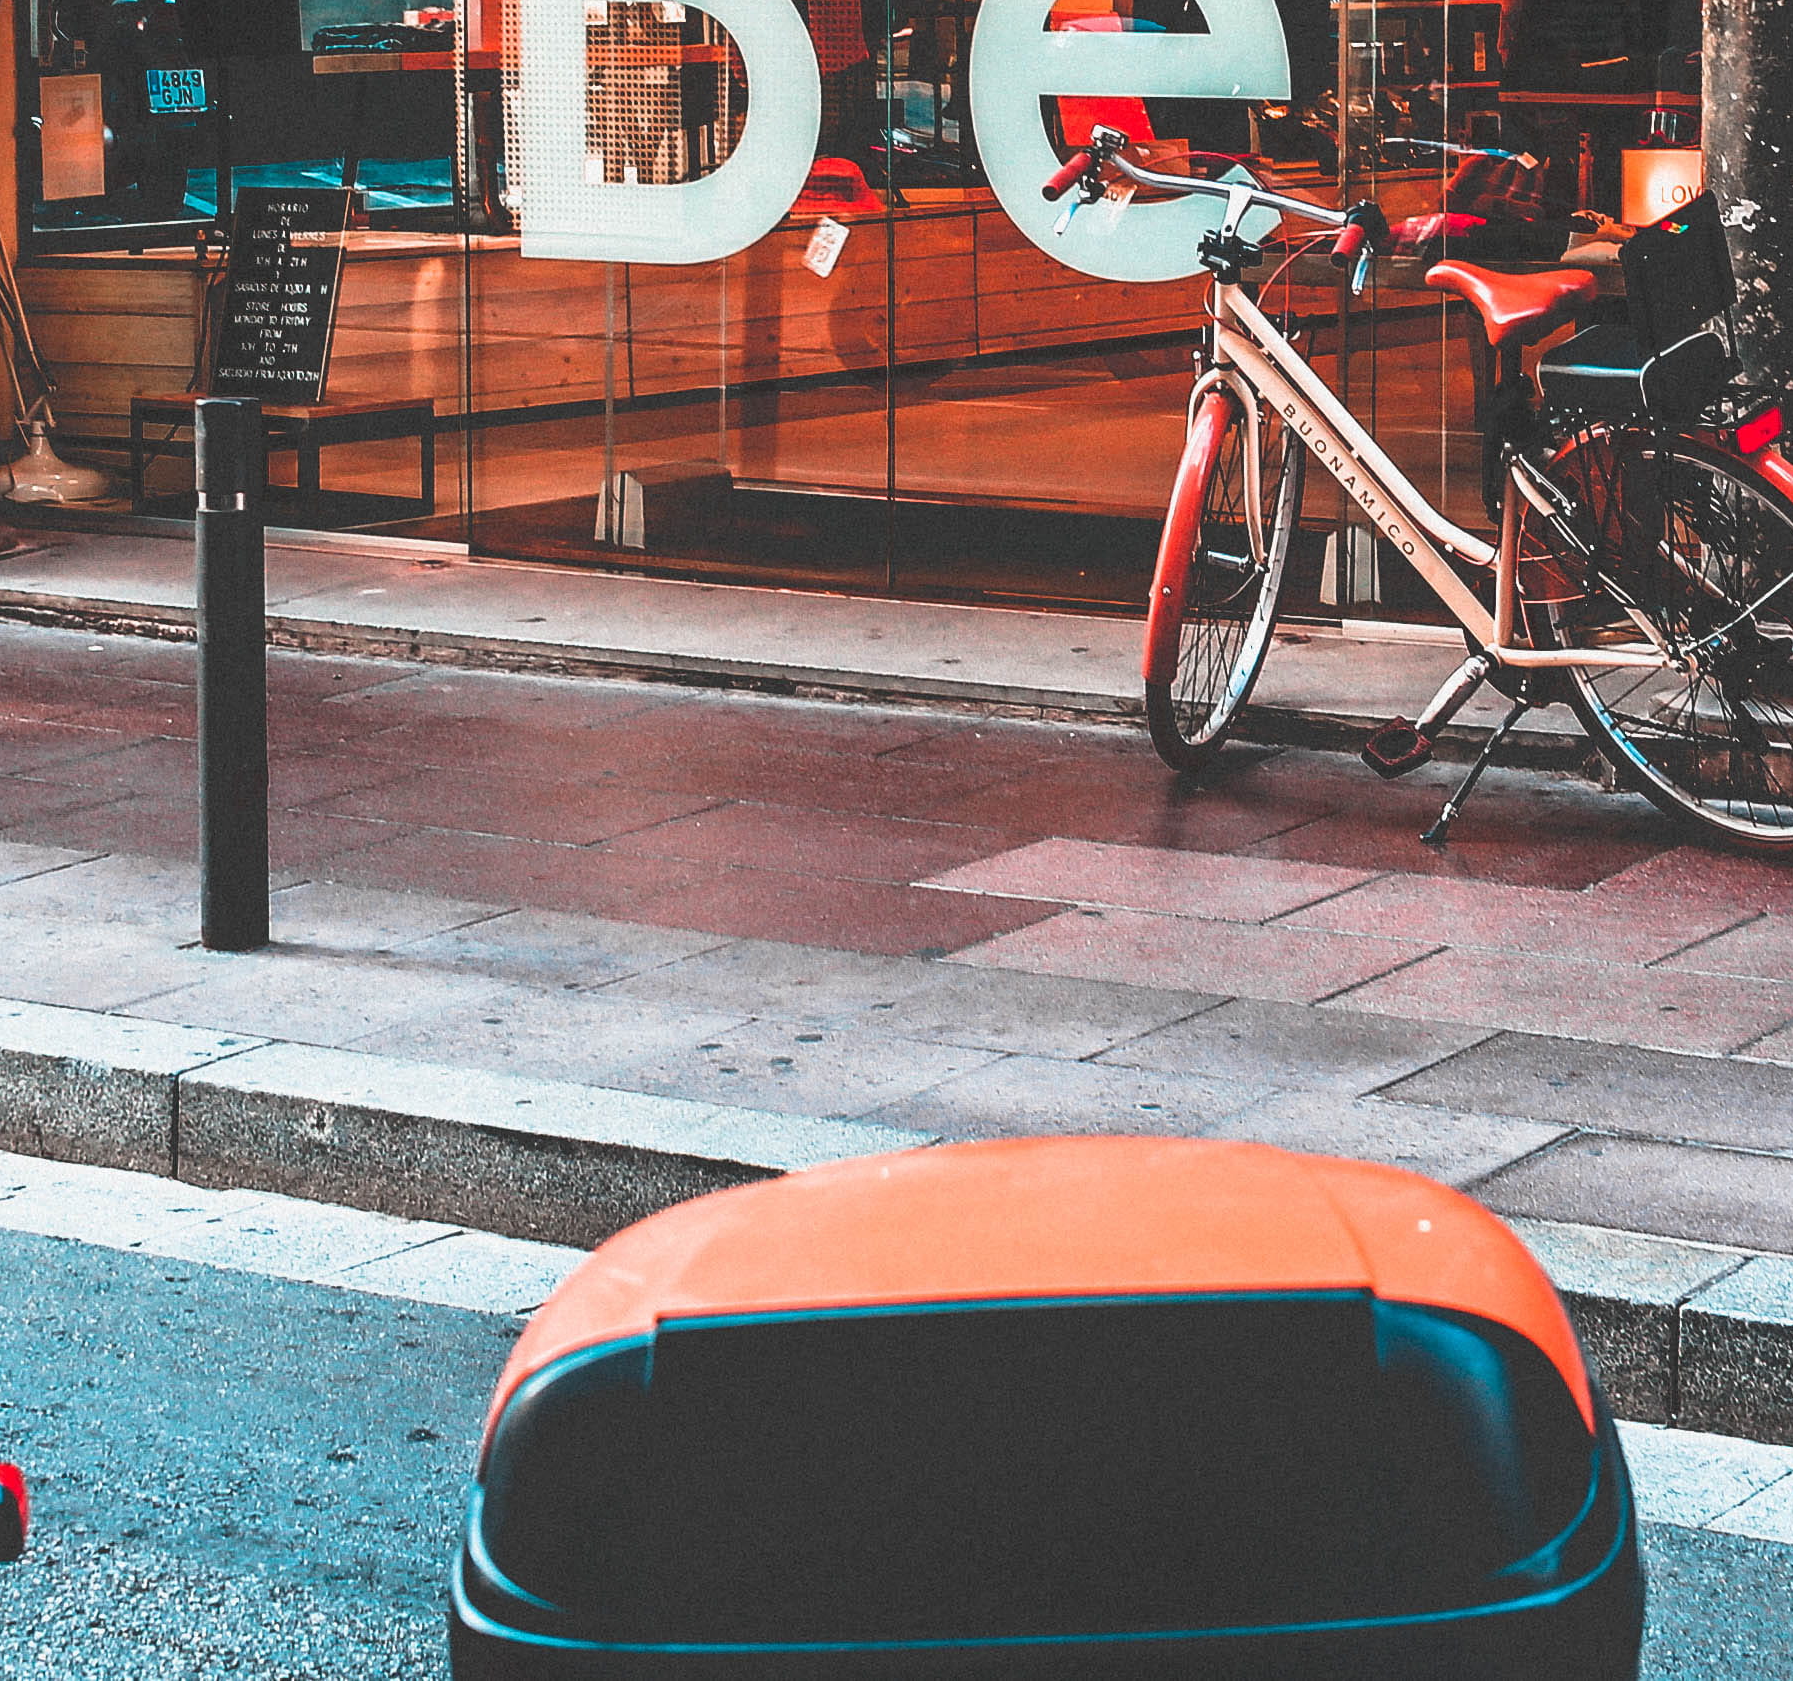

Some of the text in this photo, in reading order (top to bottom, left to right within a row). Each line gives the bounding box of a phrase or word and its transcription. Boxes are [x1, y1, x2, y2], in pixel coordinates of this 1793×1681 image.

[162, 70, 202, 88] 4849
[162, 87, 194, 105] GJN
[1283, 403, 1415, 556] BUONAMICO
